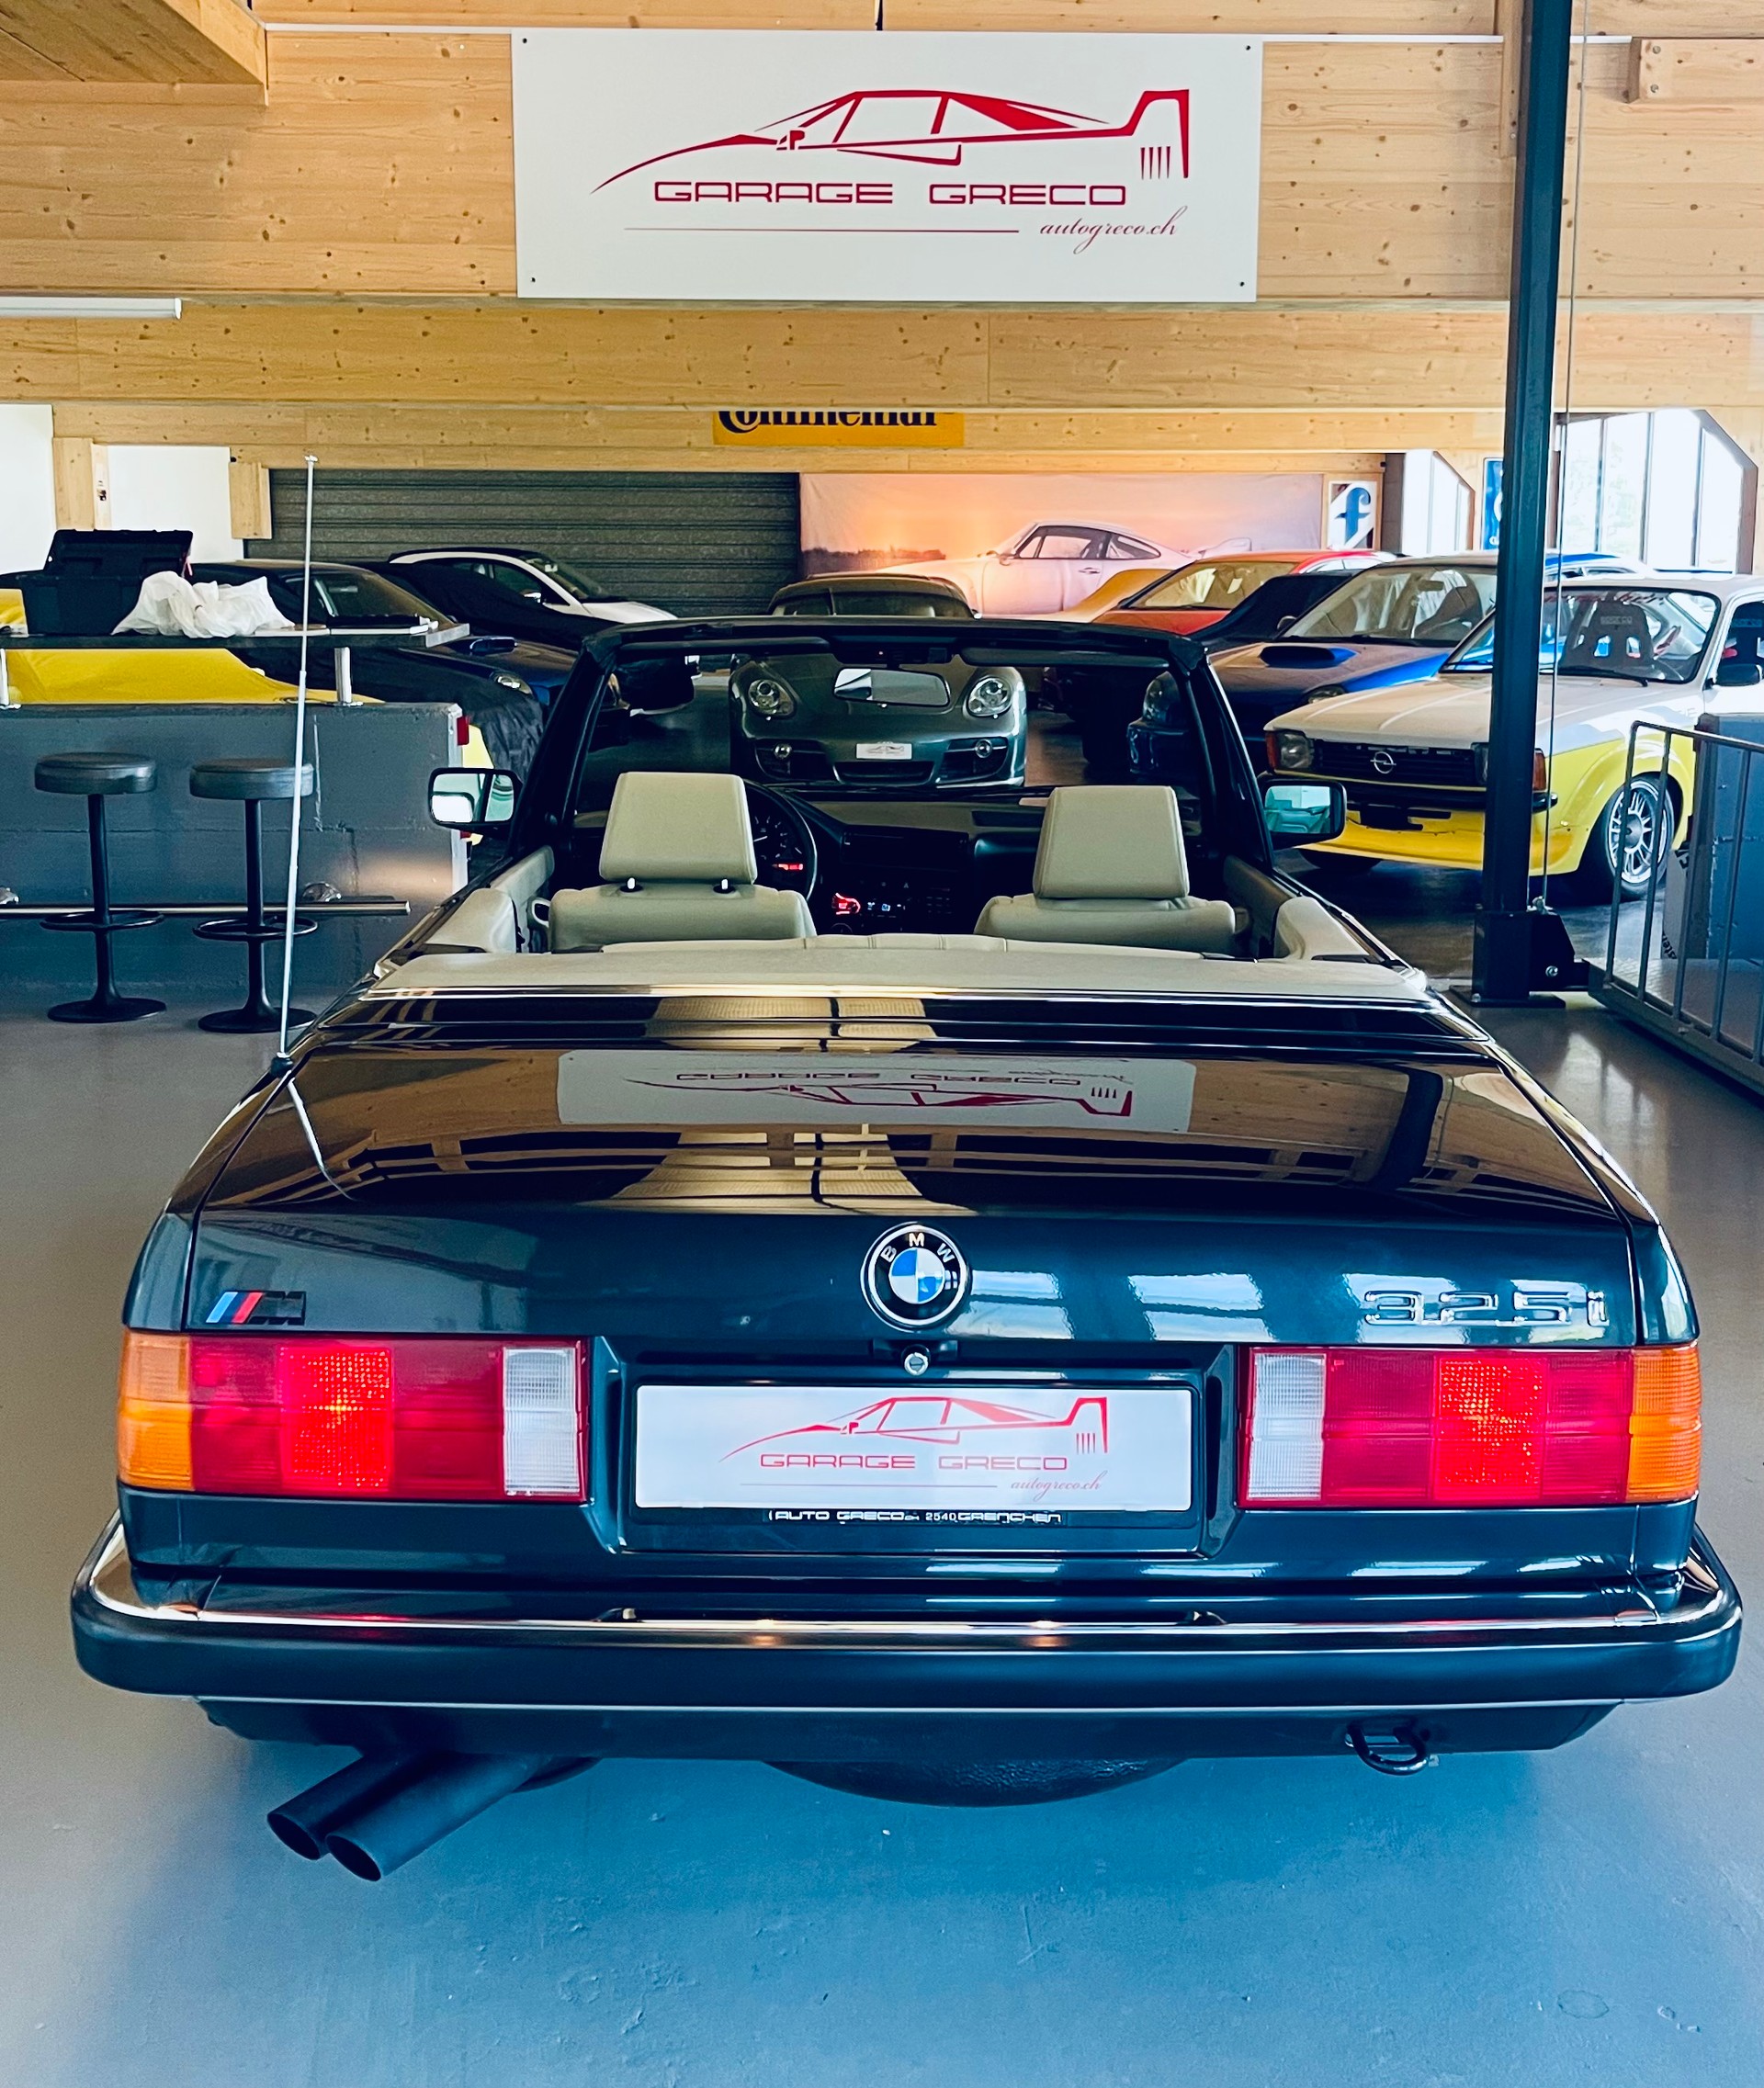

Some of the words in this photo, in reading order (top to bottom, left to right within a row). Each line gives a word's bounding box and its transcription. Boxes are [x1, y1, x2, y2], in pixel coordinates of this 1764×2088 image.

[653, 181, 894, 205] GARAGE
[928, 183, 1126, 206] GRECO
[1039, 205, 1187, 255] autogreco.ch
[880, 1232, 955, 1263] BMW
[1363, 1290, 1610, 1326] 325i
[760, 1453, 915, 1469] GARAGE
[938, 1455, 1068, 1471] GRECO
[1011, 1470, 1108, 1501] autogreco.ch
